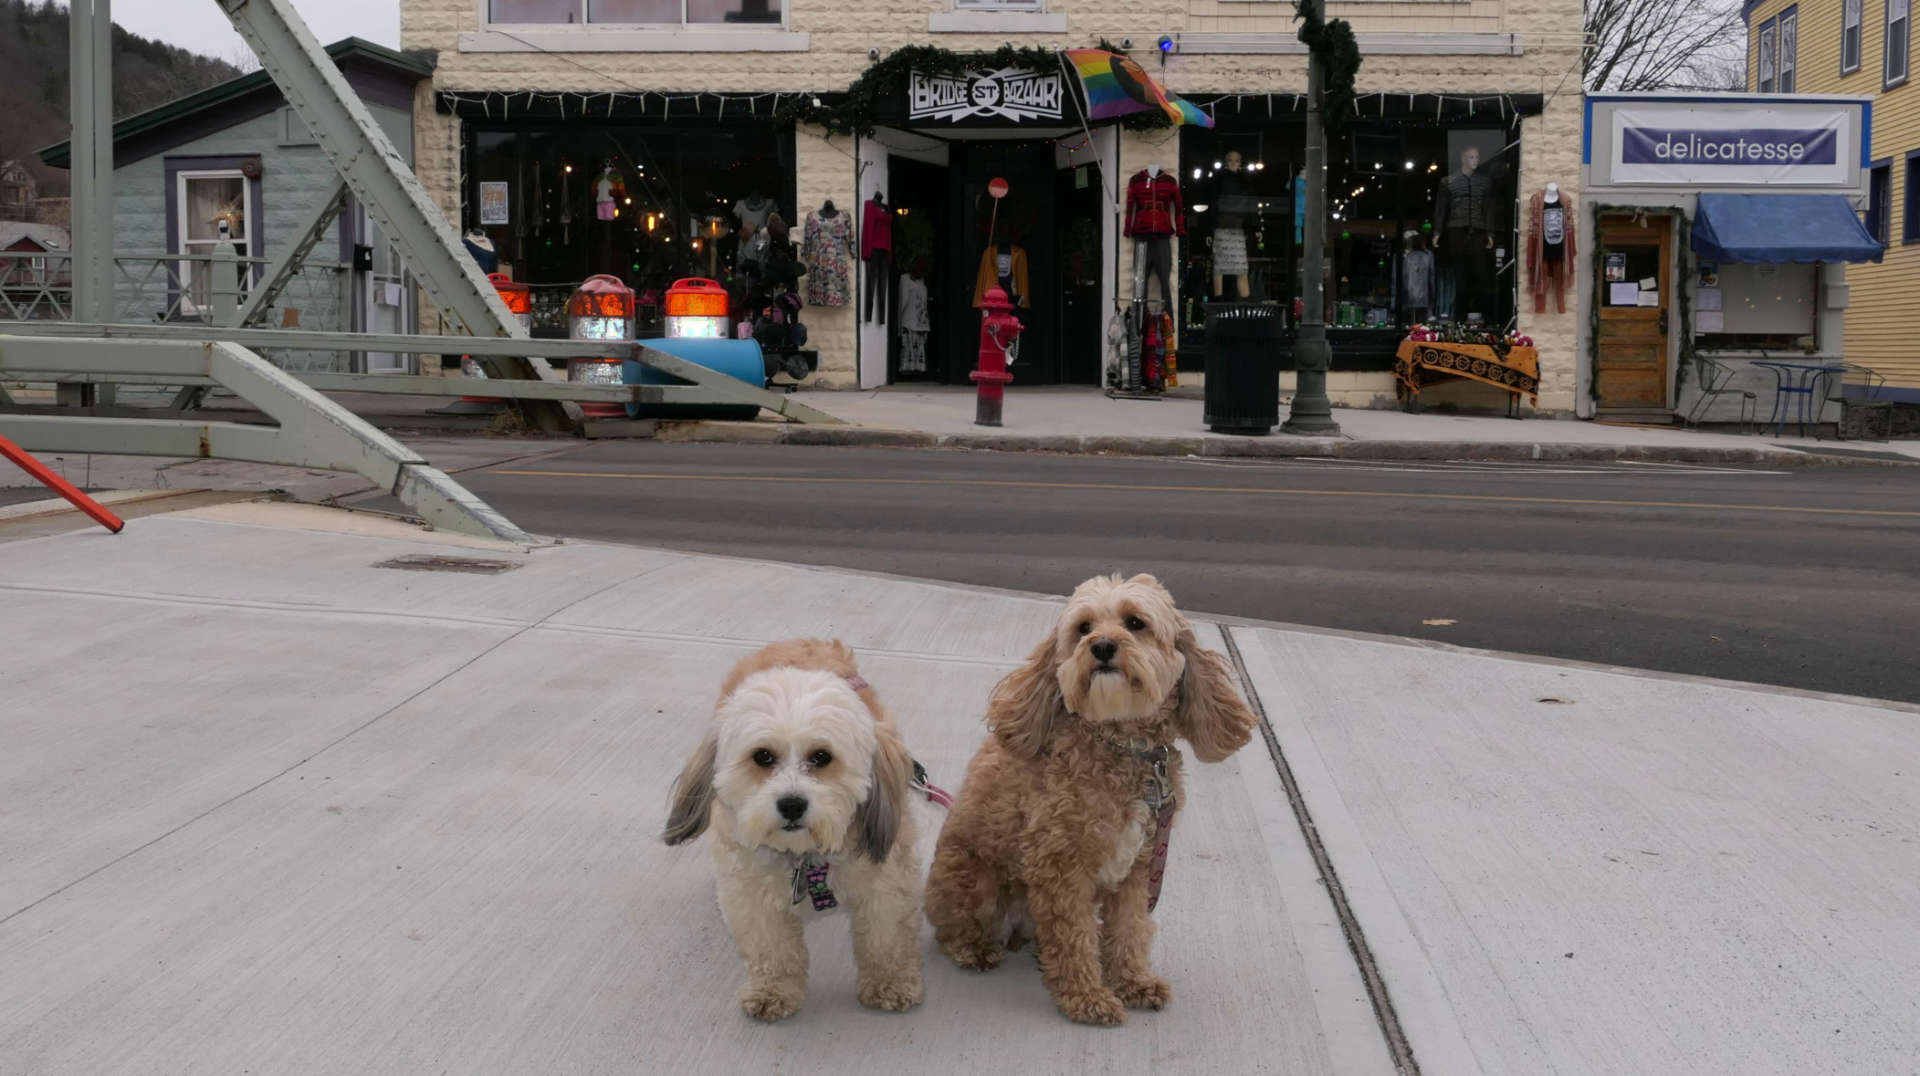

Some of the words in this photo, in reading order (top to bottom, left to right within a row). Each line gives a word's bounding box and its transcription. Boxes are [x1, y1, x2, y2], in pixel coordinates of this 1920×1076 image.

[914, 75, 968, 109] BRIDGE
[975, 85, 997, 99] ST
[1003, 76, 1058, 109] BAZAAR
[1655, 132, 1805, 159] delicatesse
